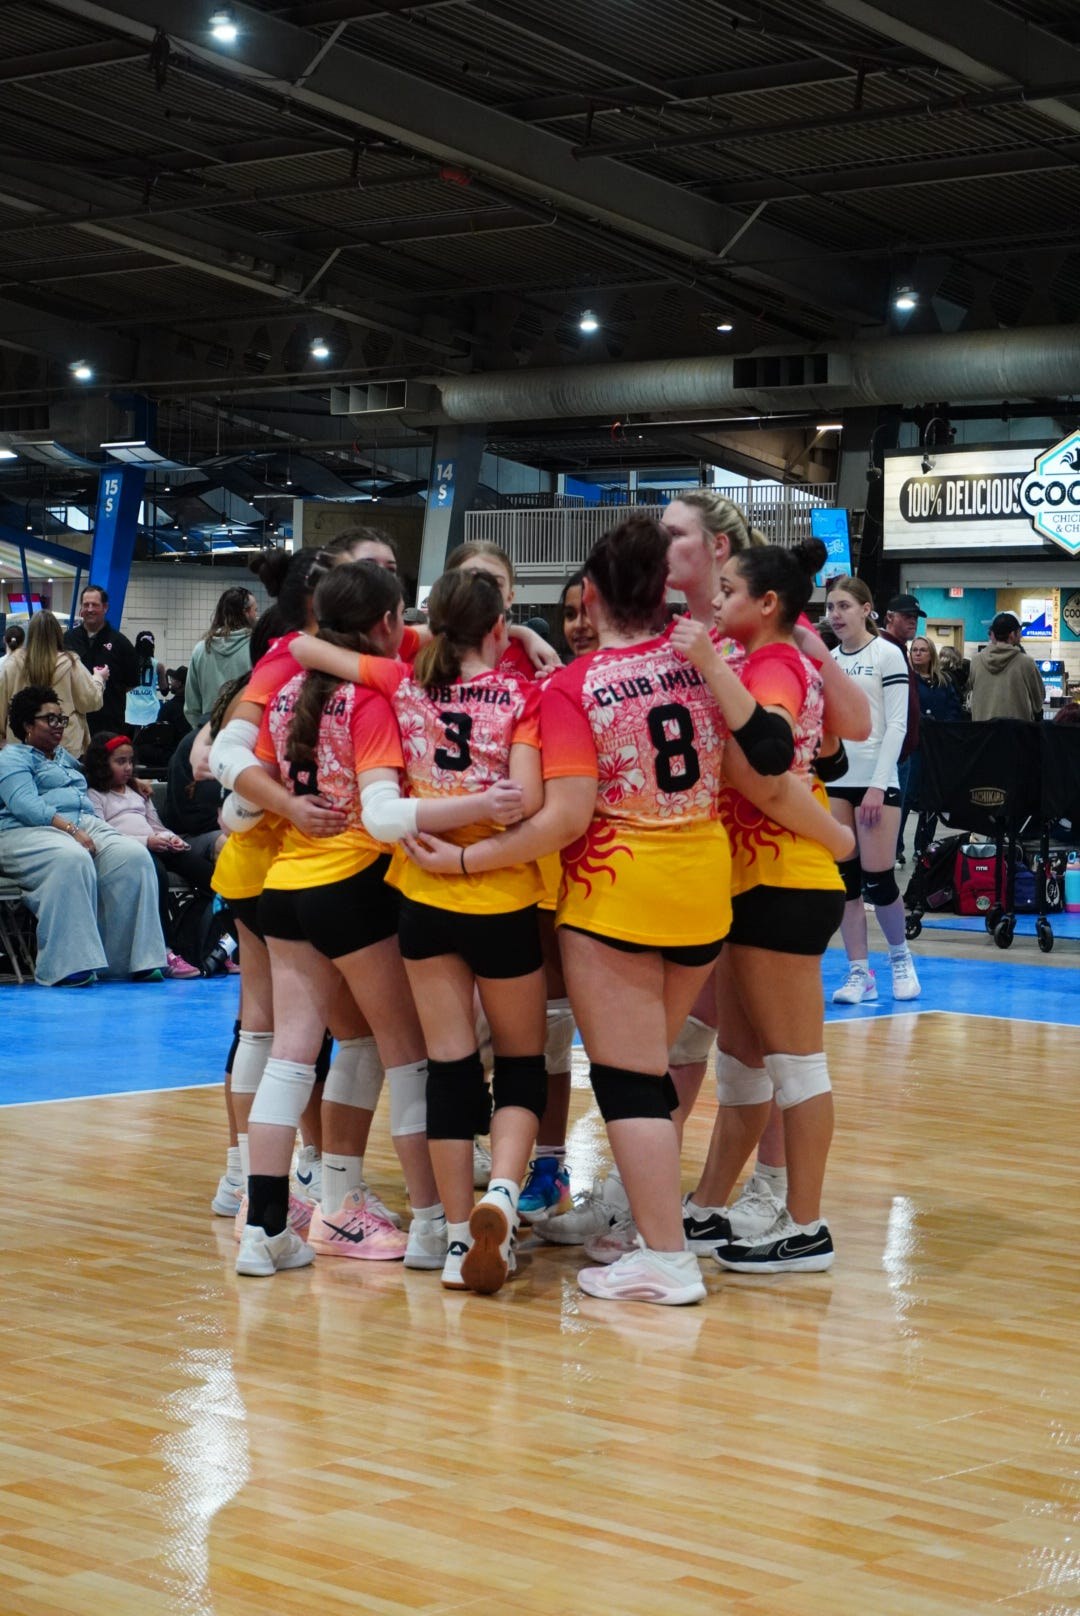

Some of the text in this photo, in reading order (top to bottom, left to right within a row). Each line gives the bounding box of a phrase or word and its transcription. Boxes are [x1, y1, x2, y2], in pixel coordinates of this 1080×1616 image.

[437, 464, 453, 481] 14
[105, 480, 119, 496] 15
[438, 484, 447, 500] S
[105, 498, 114, 512] S
[907, 478, 1021, 517] 100% DELICIOUS
[1053, 514, 1080, 523] CHIC
[846, 662, 874, 675] VATE
[428, 686, 511, 706] UB IMUA
[593, 668, 706, 707] CLUB IMU
[434, 712, 472, 772] 3
[647, 702, 700, 793] 8
